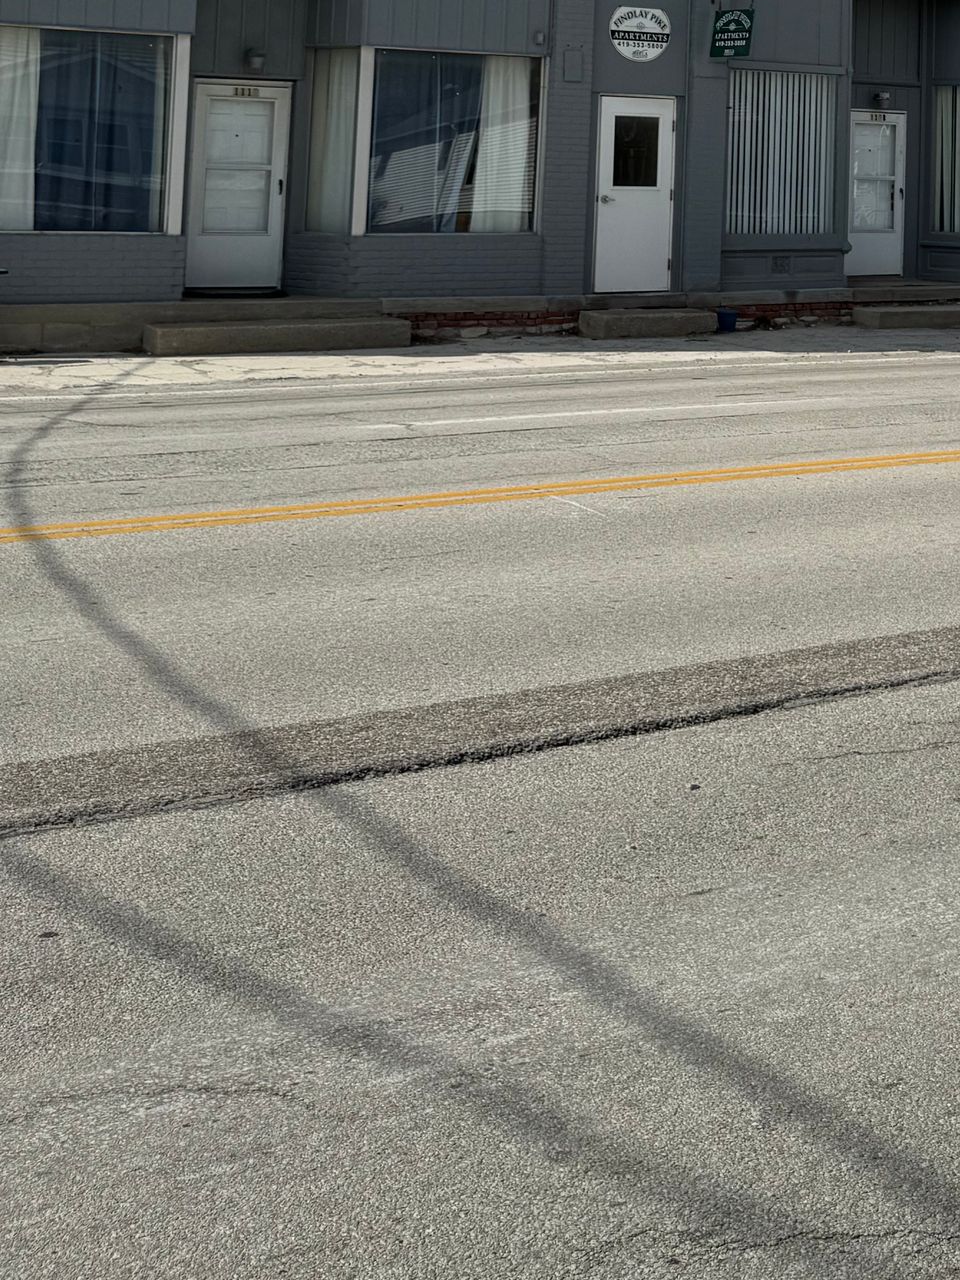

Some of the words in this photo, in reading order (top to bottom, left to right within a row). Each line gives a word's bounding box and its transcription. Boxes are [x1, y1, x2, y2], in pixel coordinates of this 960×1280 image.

[613, 9, 649, 28] FINDLAY
[650, 13, 667, 32] PIKE
[613, 31, 668, 42] APARTMENTS
[617, 41, 664, 50] 419-353-5800
